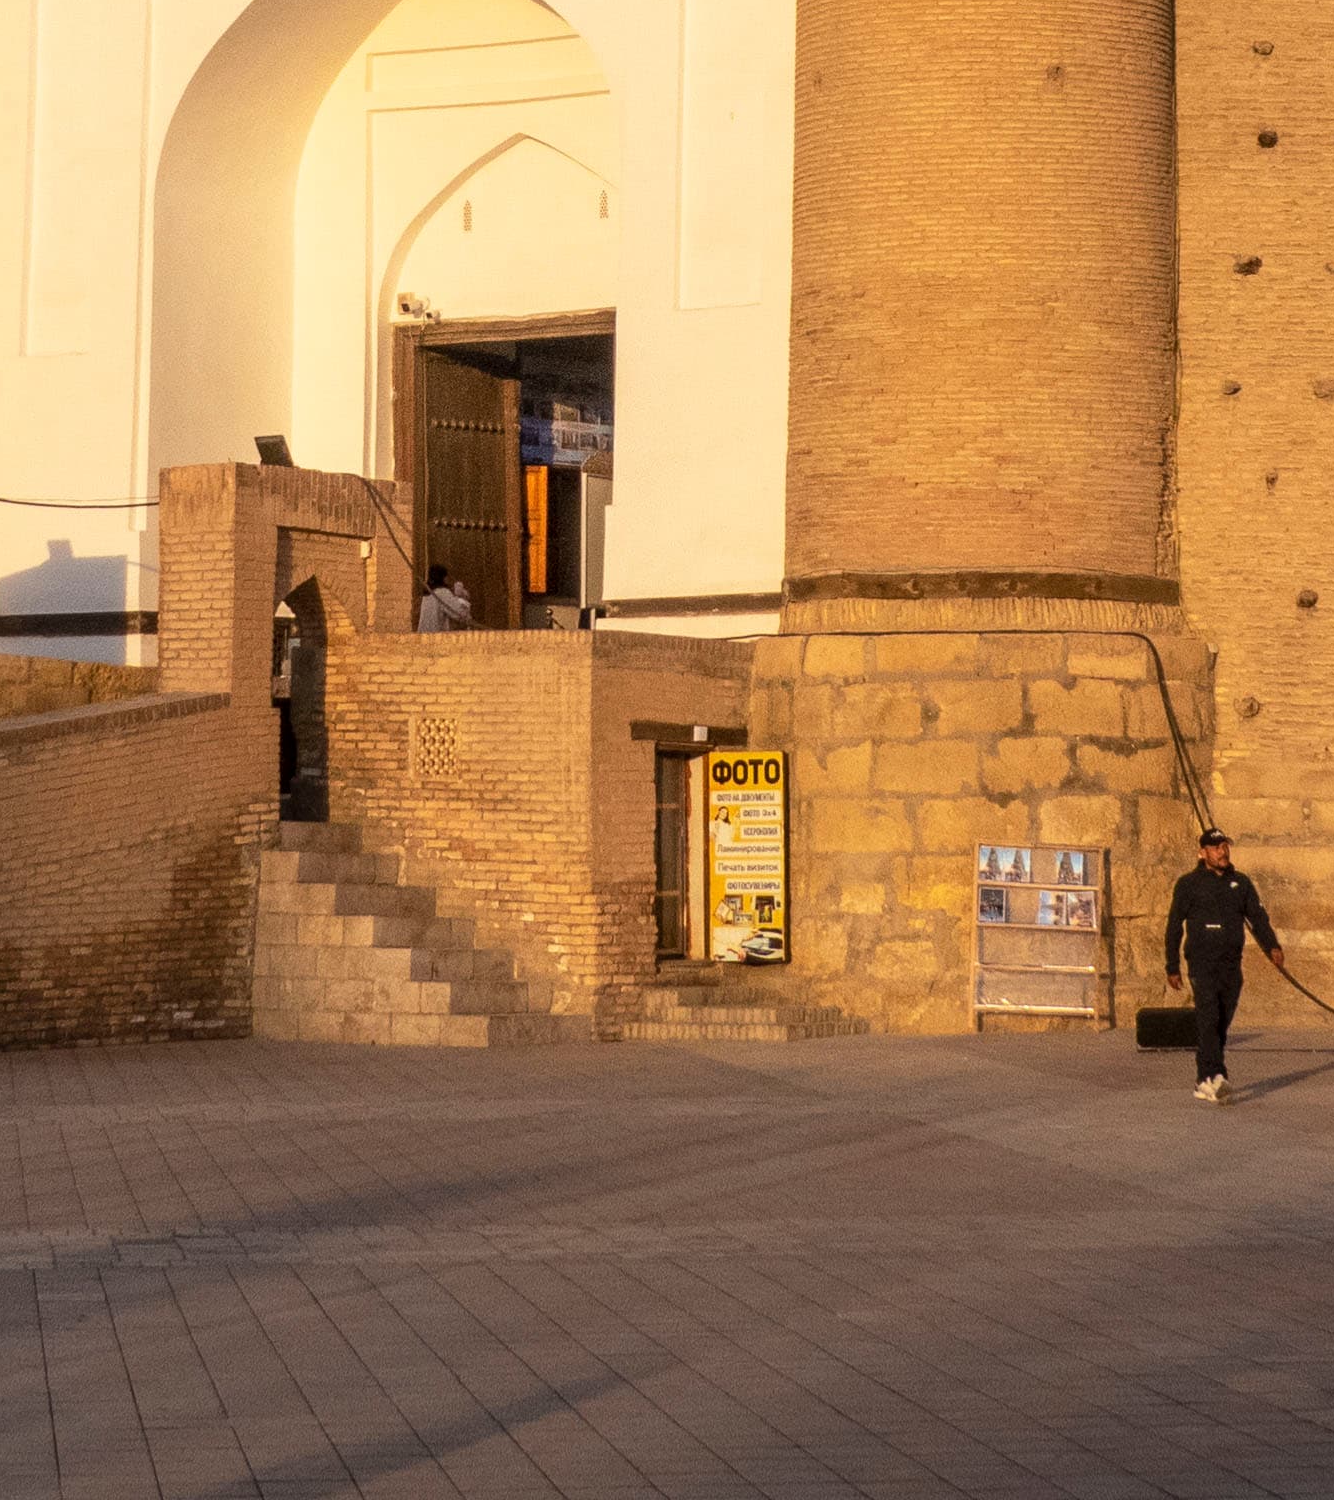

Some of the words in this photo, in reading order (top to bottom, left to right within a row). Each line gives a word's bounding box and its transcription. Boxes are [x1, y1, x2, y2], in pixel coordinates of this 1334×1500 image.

[712, 758, 781, 786] ФОТО
[717, 843, 780, 854] Ламинирование
[717, 862, 745, 872] Печать
[746, 863, 779, 872] визиток
[727, 881, 781, 890] ФОТОСУВЕНИРЫ
